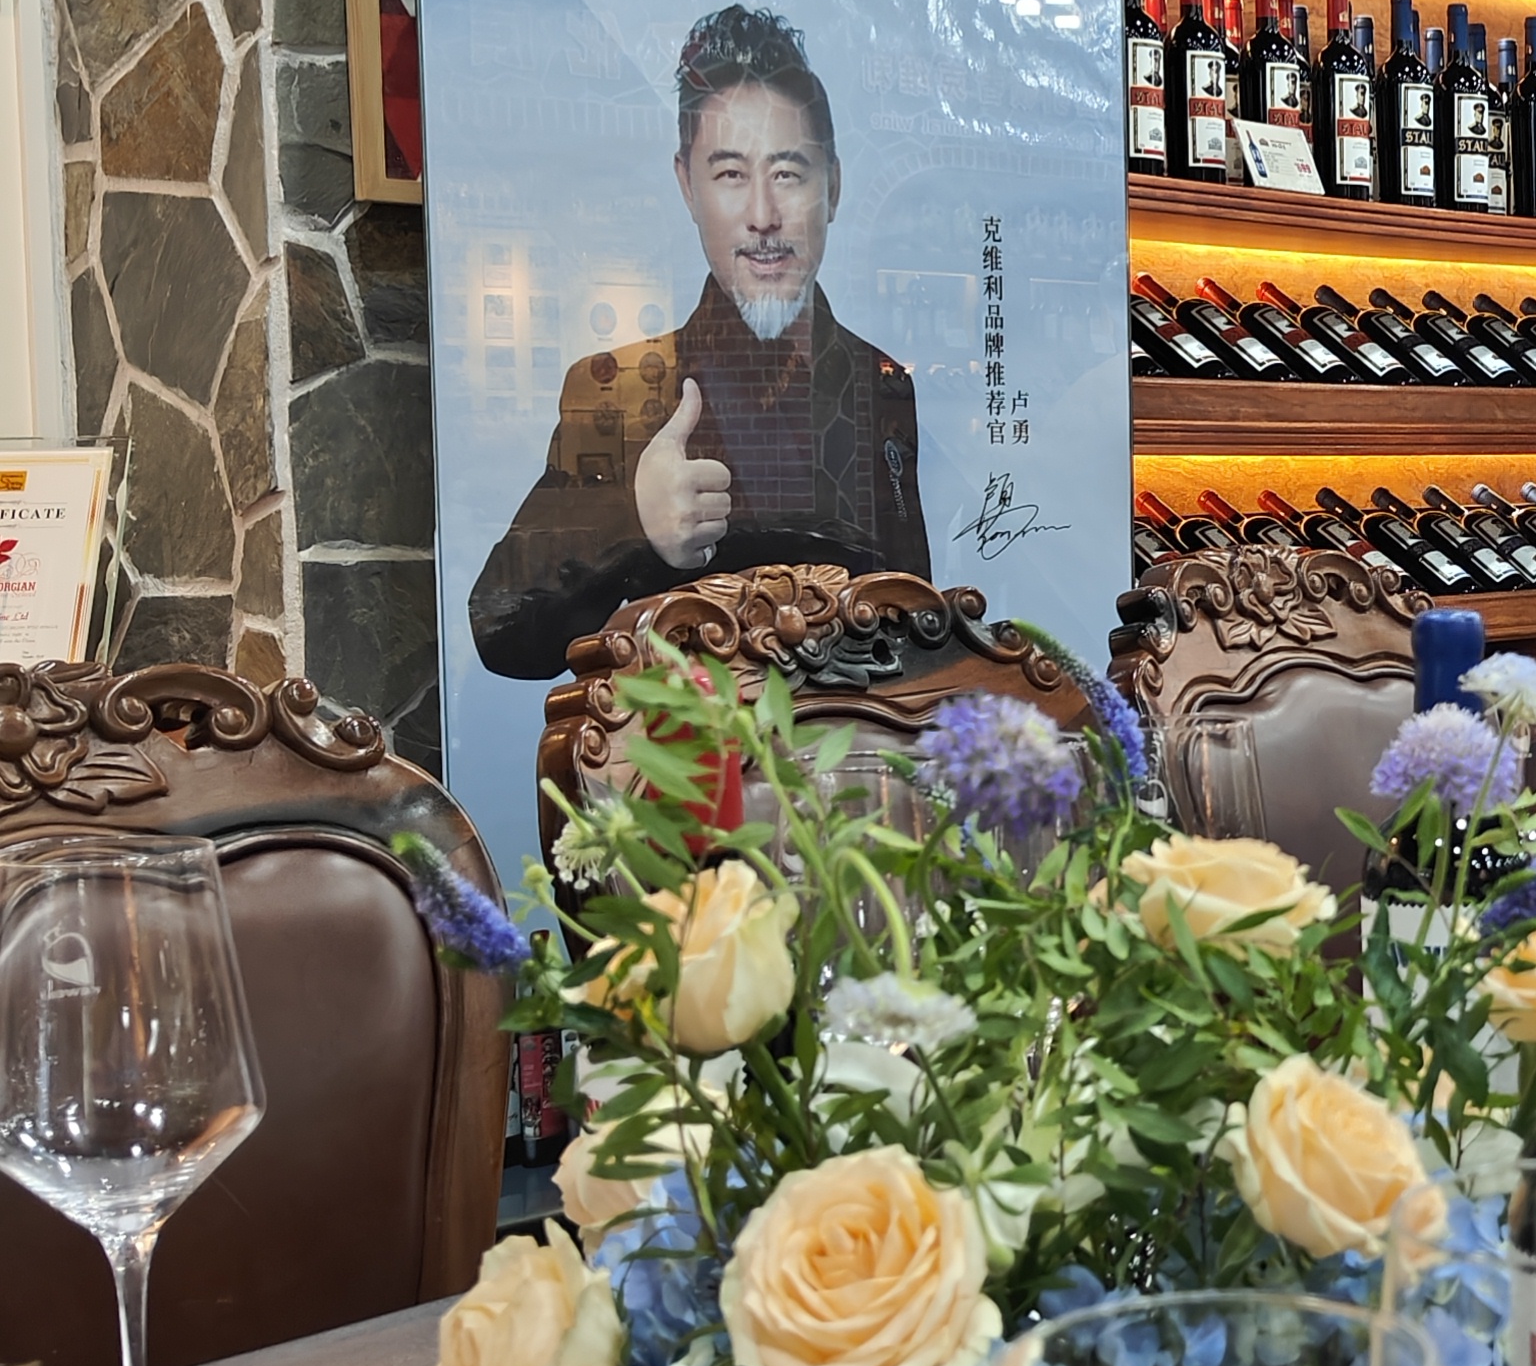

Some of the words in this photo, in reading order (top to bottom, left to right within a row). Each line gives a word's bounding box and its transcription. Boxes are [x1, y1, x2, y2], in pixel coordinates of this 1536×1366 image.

[982, 216, 1006, 446] 克维利品牌推荐官
[1010, 389, 1030, 446] 卢勇
